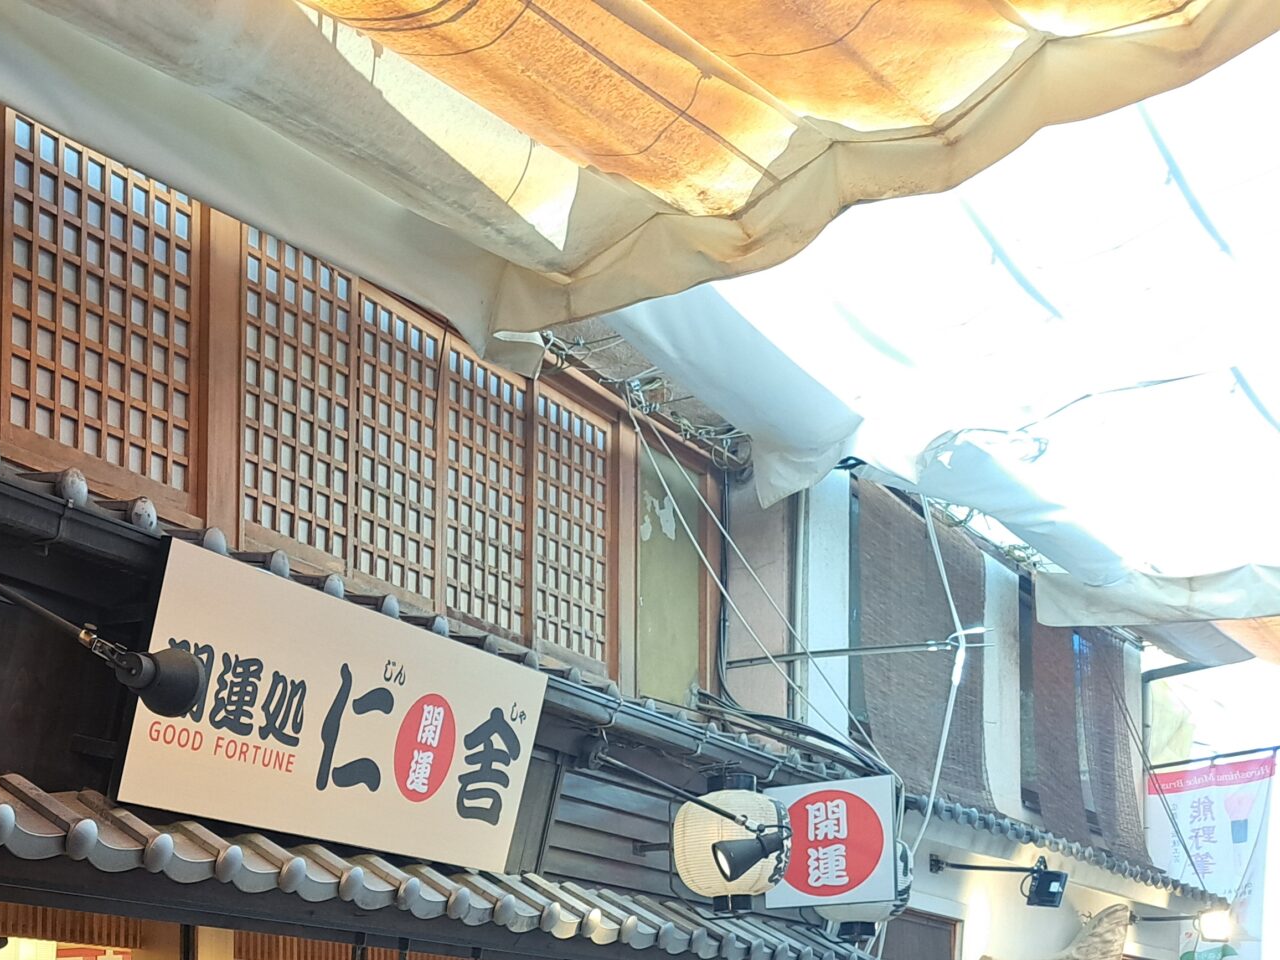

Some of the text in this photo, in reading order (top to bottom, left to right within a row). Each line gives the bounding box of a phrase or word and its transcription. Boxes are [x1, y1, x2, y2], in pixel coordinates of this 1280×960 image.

[384, 660, 406, 686] じん
[148, 721, 296, 773] GOOD FORTUNE
[316, 663, 521, 826] 仁 舎
[509, 702, 527, 724] しゃ
[406, 704, 445, 793] 開運
[805, 799, 850, 888] 開運
